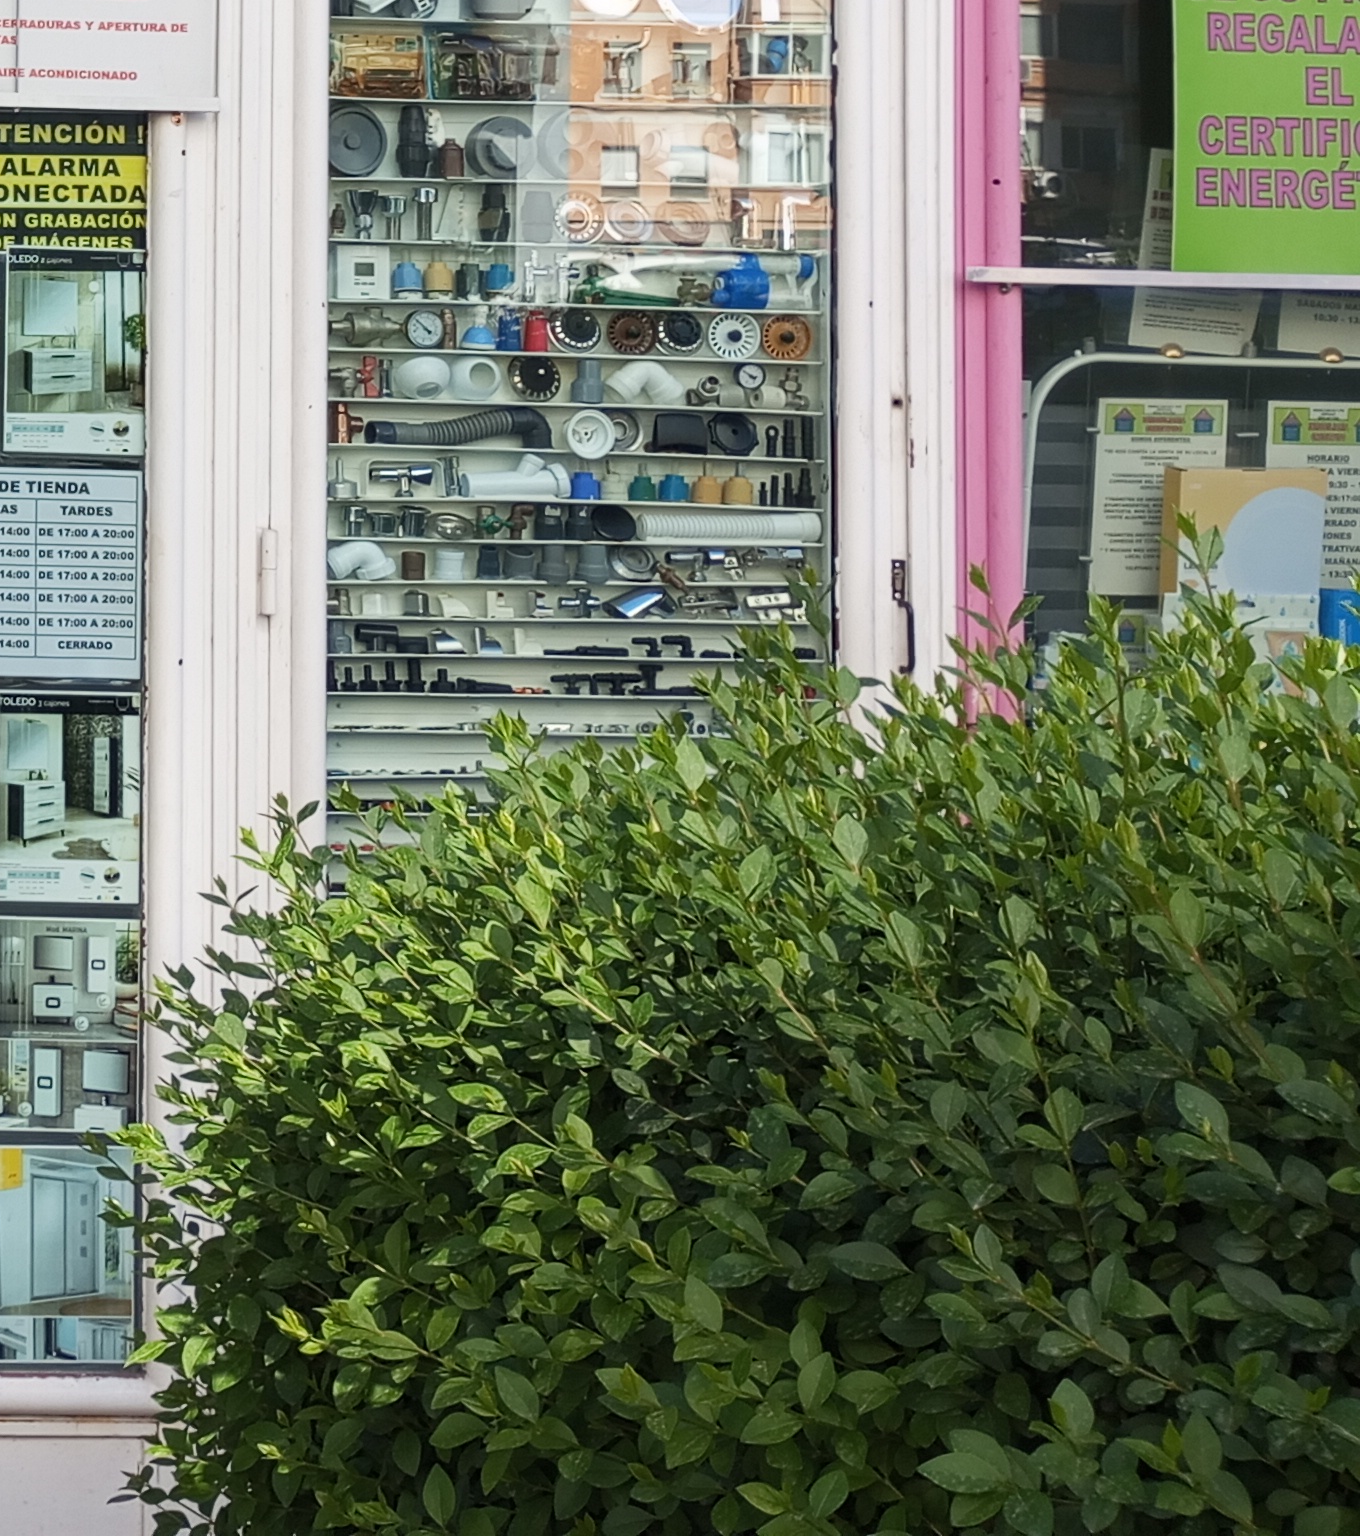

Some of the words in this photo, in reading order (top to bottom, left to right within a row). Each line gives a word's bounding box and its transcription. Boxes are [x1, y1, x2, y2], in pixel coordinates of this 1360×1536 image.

[1306, 67, 1353, 106] EL
[0, 157, 122, 178] ALARMA
[23, 210, 145, 230] GRABACIÓN
[25, 480, 91, 495] TIENDA
[59, 505, 113, 517] TARDES
